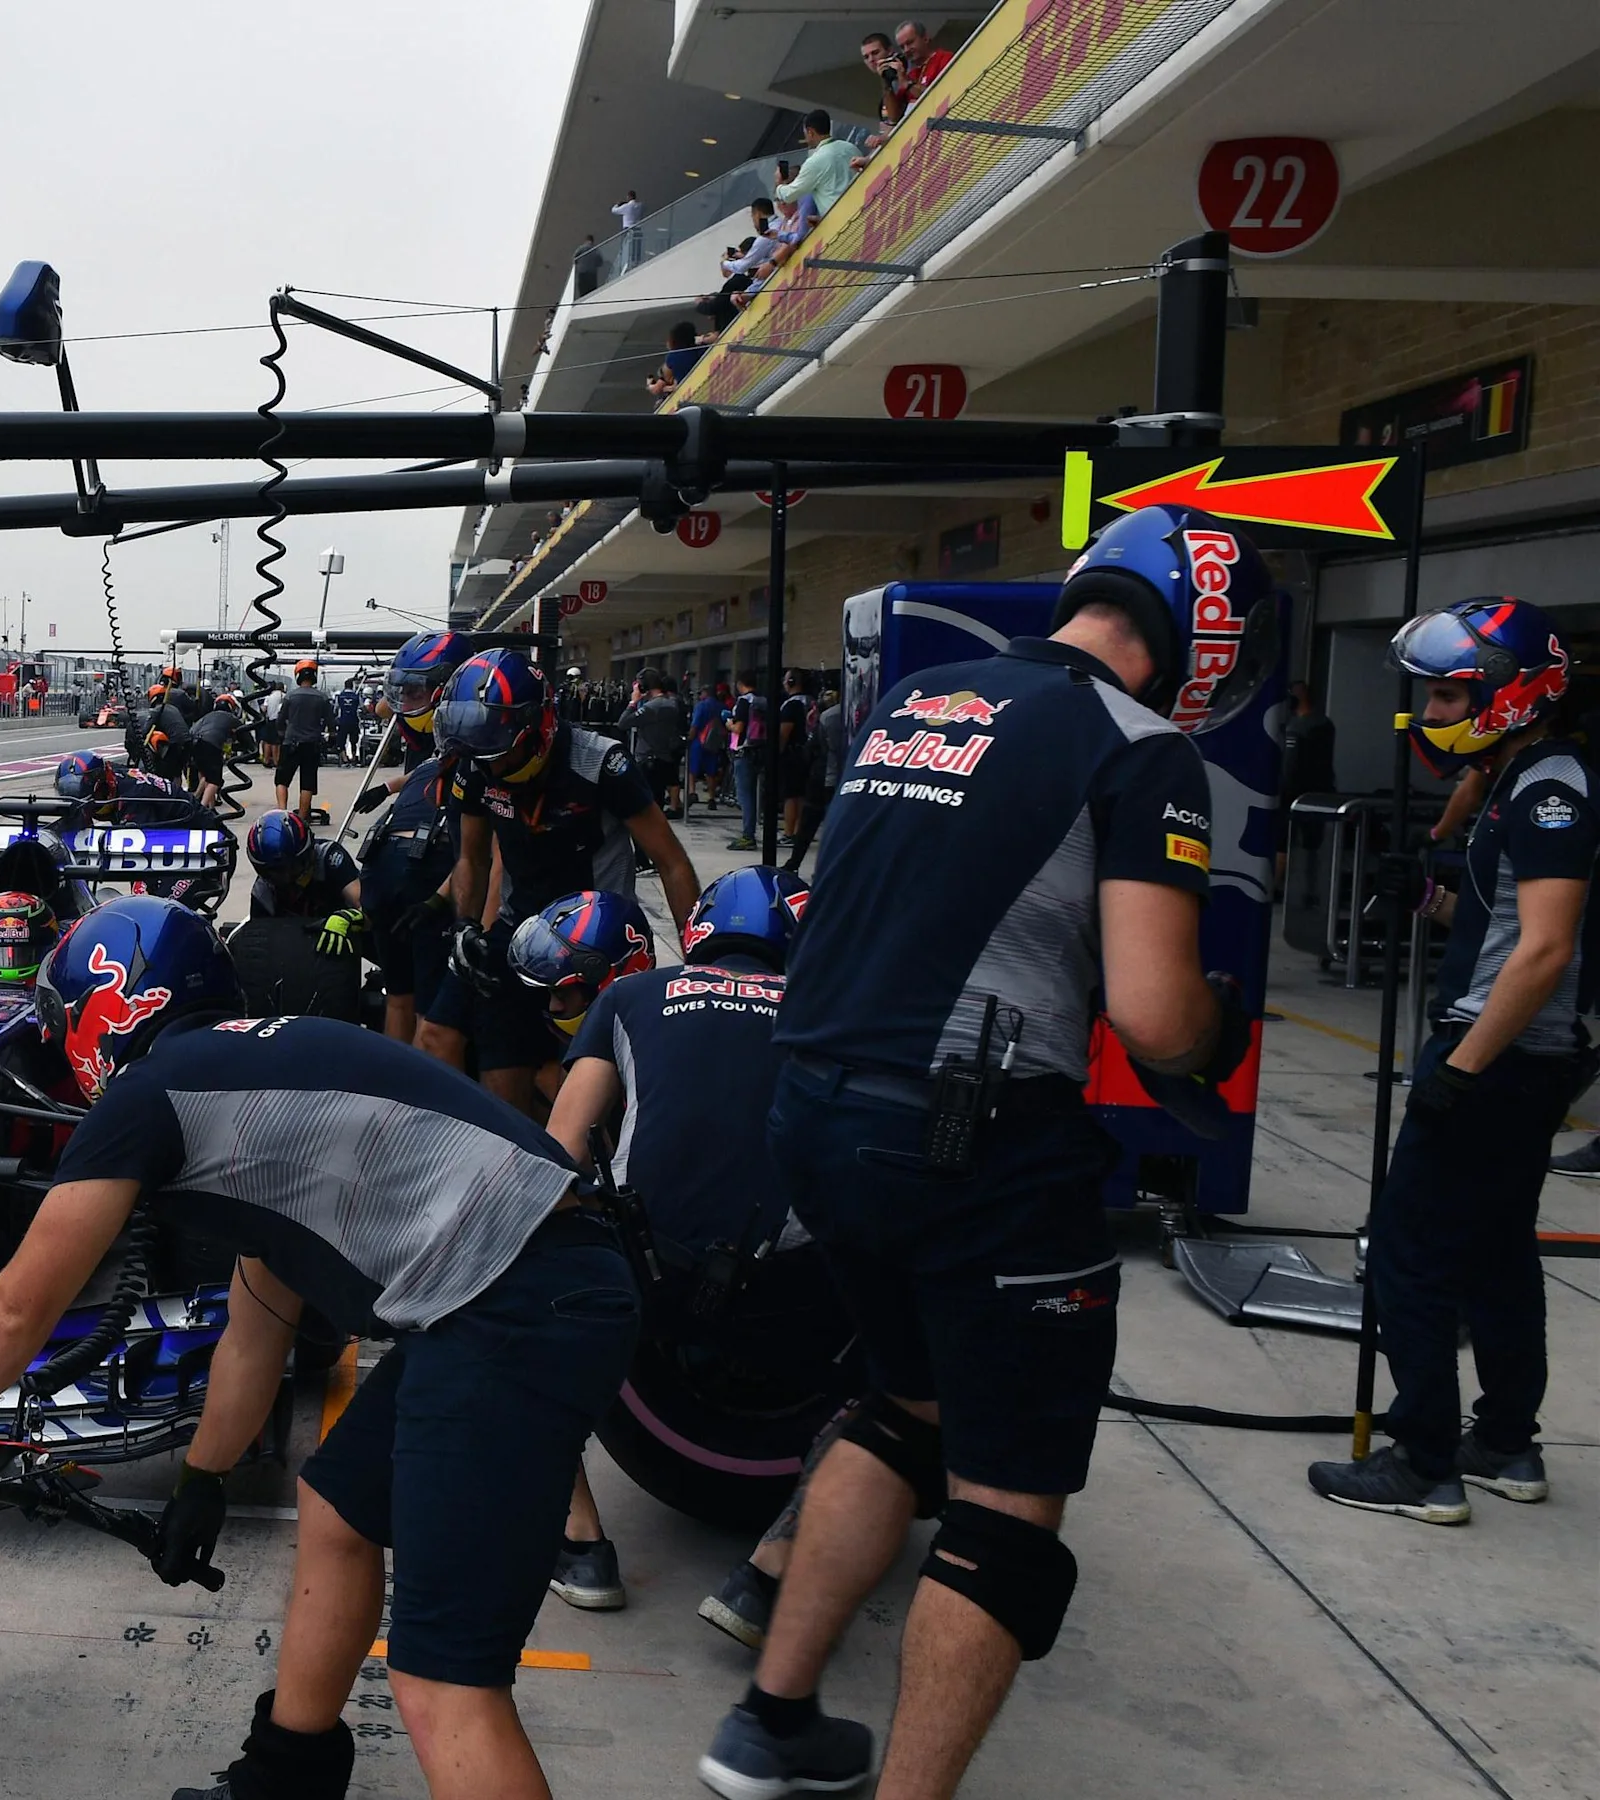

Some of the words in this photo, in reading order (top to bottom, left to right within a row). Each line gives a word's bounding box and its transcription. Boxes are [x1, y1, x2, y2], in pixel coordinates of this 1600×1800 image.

[1229, 155, 1306, 228] 22
[905, 374, 942, 418] 21
[689, 515, 709, 540] 19
[587, 582, 601, 600] 18
[1182, 530, 1246, 635] Red
[566, 597, 577, 611] 17
[207, 633, 246, 641] McLAREN
[854, 730, 926, 768] Red
[905, 732, 995, 777] Bull
[868, 779, 901, 797] YOU
[902, 783, 966, 807] WINGS
[1162, 802, 1209, 830] Acro
[1537, 805, 1573, 814] Estrella
[1538, 813, 1571, 822] Galicia
[106, 828, 222, 871] Bull
[10, 927, 30, 938] Bull
[666, 978, 735, 1000] Red
[737, 981, 785, 1003] Bu
[662, 1000, 706, 1017] GIVES
[711, 1000, 747, 1012] YOU
[1055, 1303, 1080, 1314] Toro
